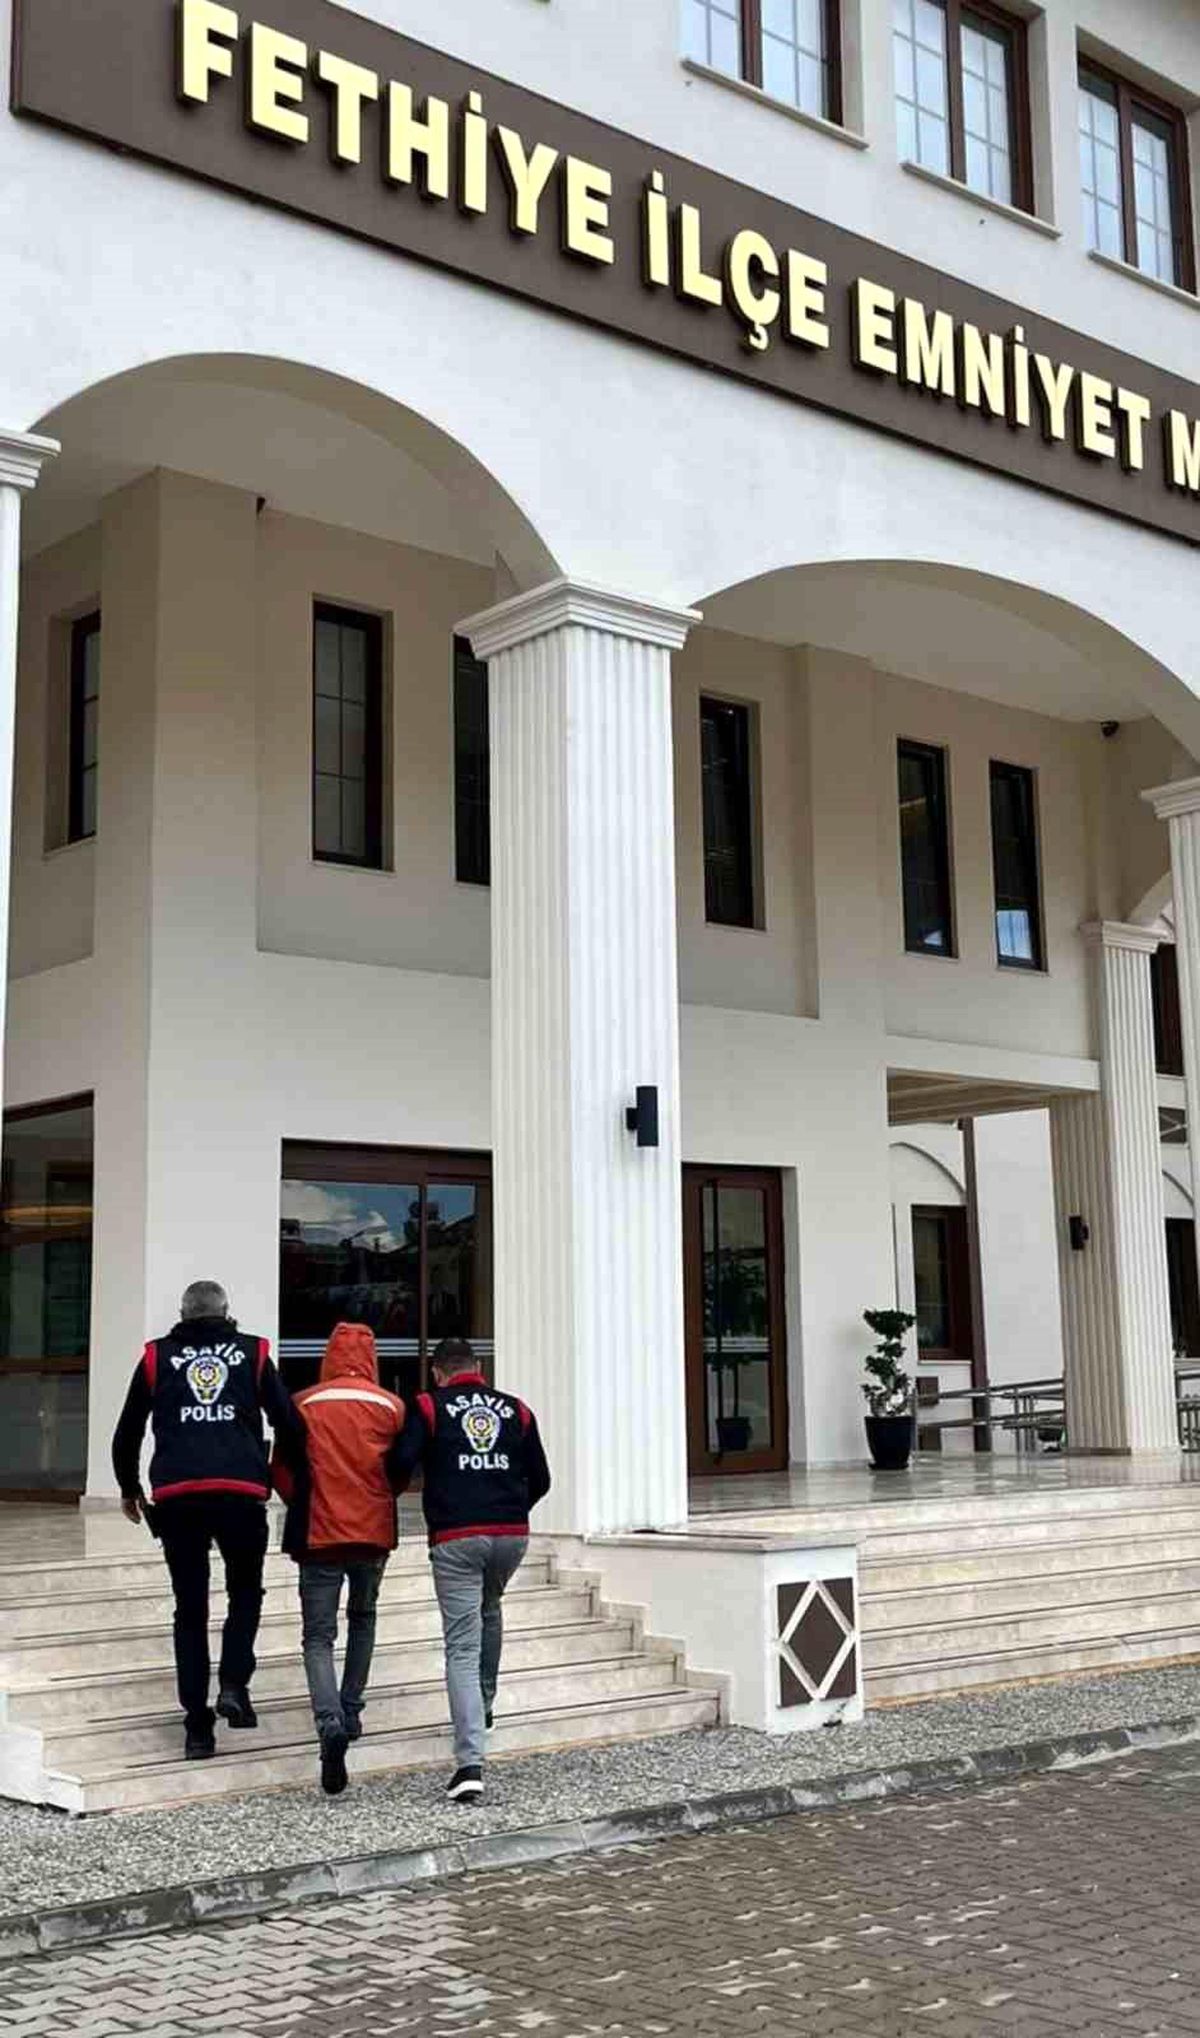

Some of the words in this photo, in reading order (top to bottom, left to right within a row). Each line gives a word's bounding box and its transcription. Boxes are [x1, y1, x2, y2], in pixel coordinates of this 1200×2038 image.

[181, 0, 615, 265] FETHİYE
[646, 169, 830, 351] İLÇE
[856, 277, 1151, 471] EMNİYET
